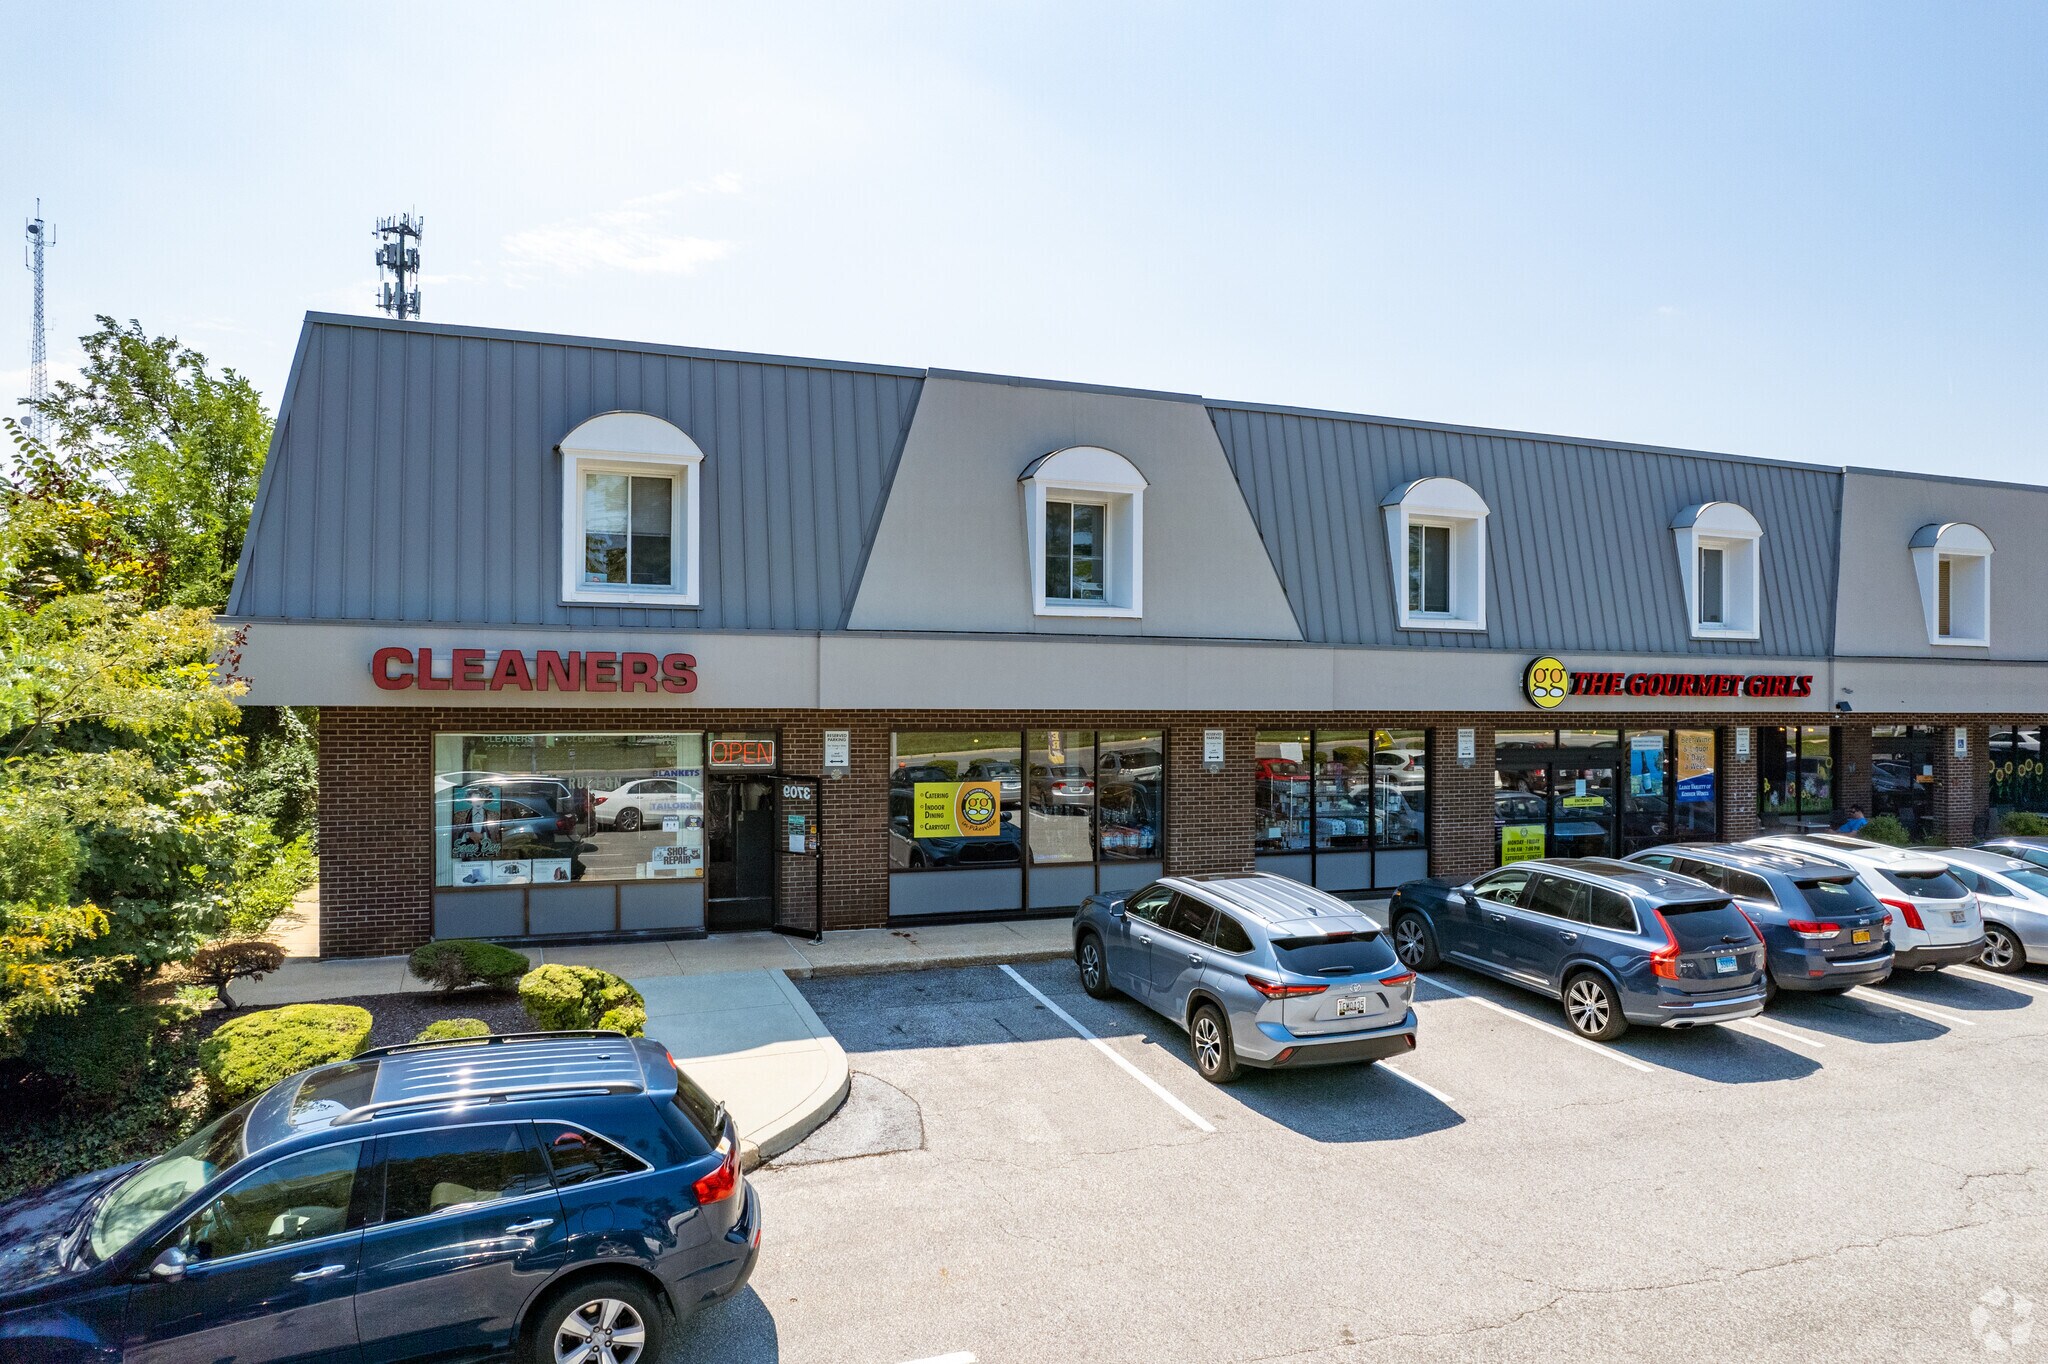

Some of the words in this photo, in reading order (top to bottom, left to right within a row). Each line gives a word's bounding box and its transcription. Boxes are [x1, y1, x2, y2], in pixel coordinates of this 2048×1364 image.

[372, 646, 698, 694] CLEANERS
[1572, 672, 1625, 696] THE
[1628, 672, 1745, 698] GOURMET
[1748, 674, 1813, 698] GIRLS
[482, 735, 534, 743] CLEANERS
[711, 741, 772, 764] OPEN
[1691, 753, 1706, 763] Days
[652, 768, 700, 778] BLANKETS
[481, 838, 501, 856] Day
[667, 846, 688, 856] SHOE
[663, 855, 691, 865] REPAIR
